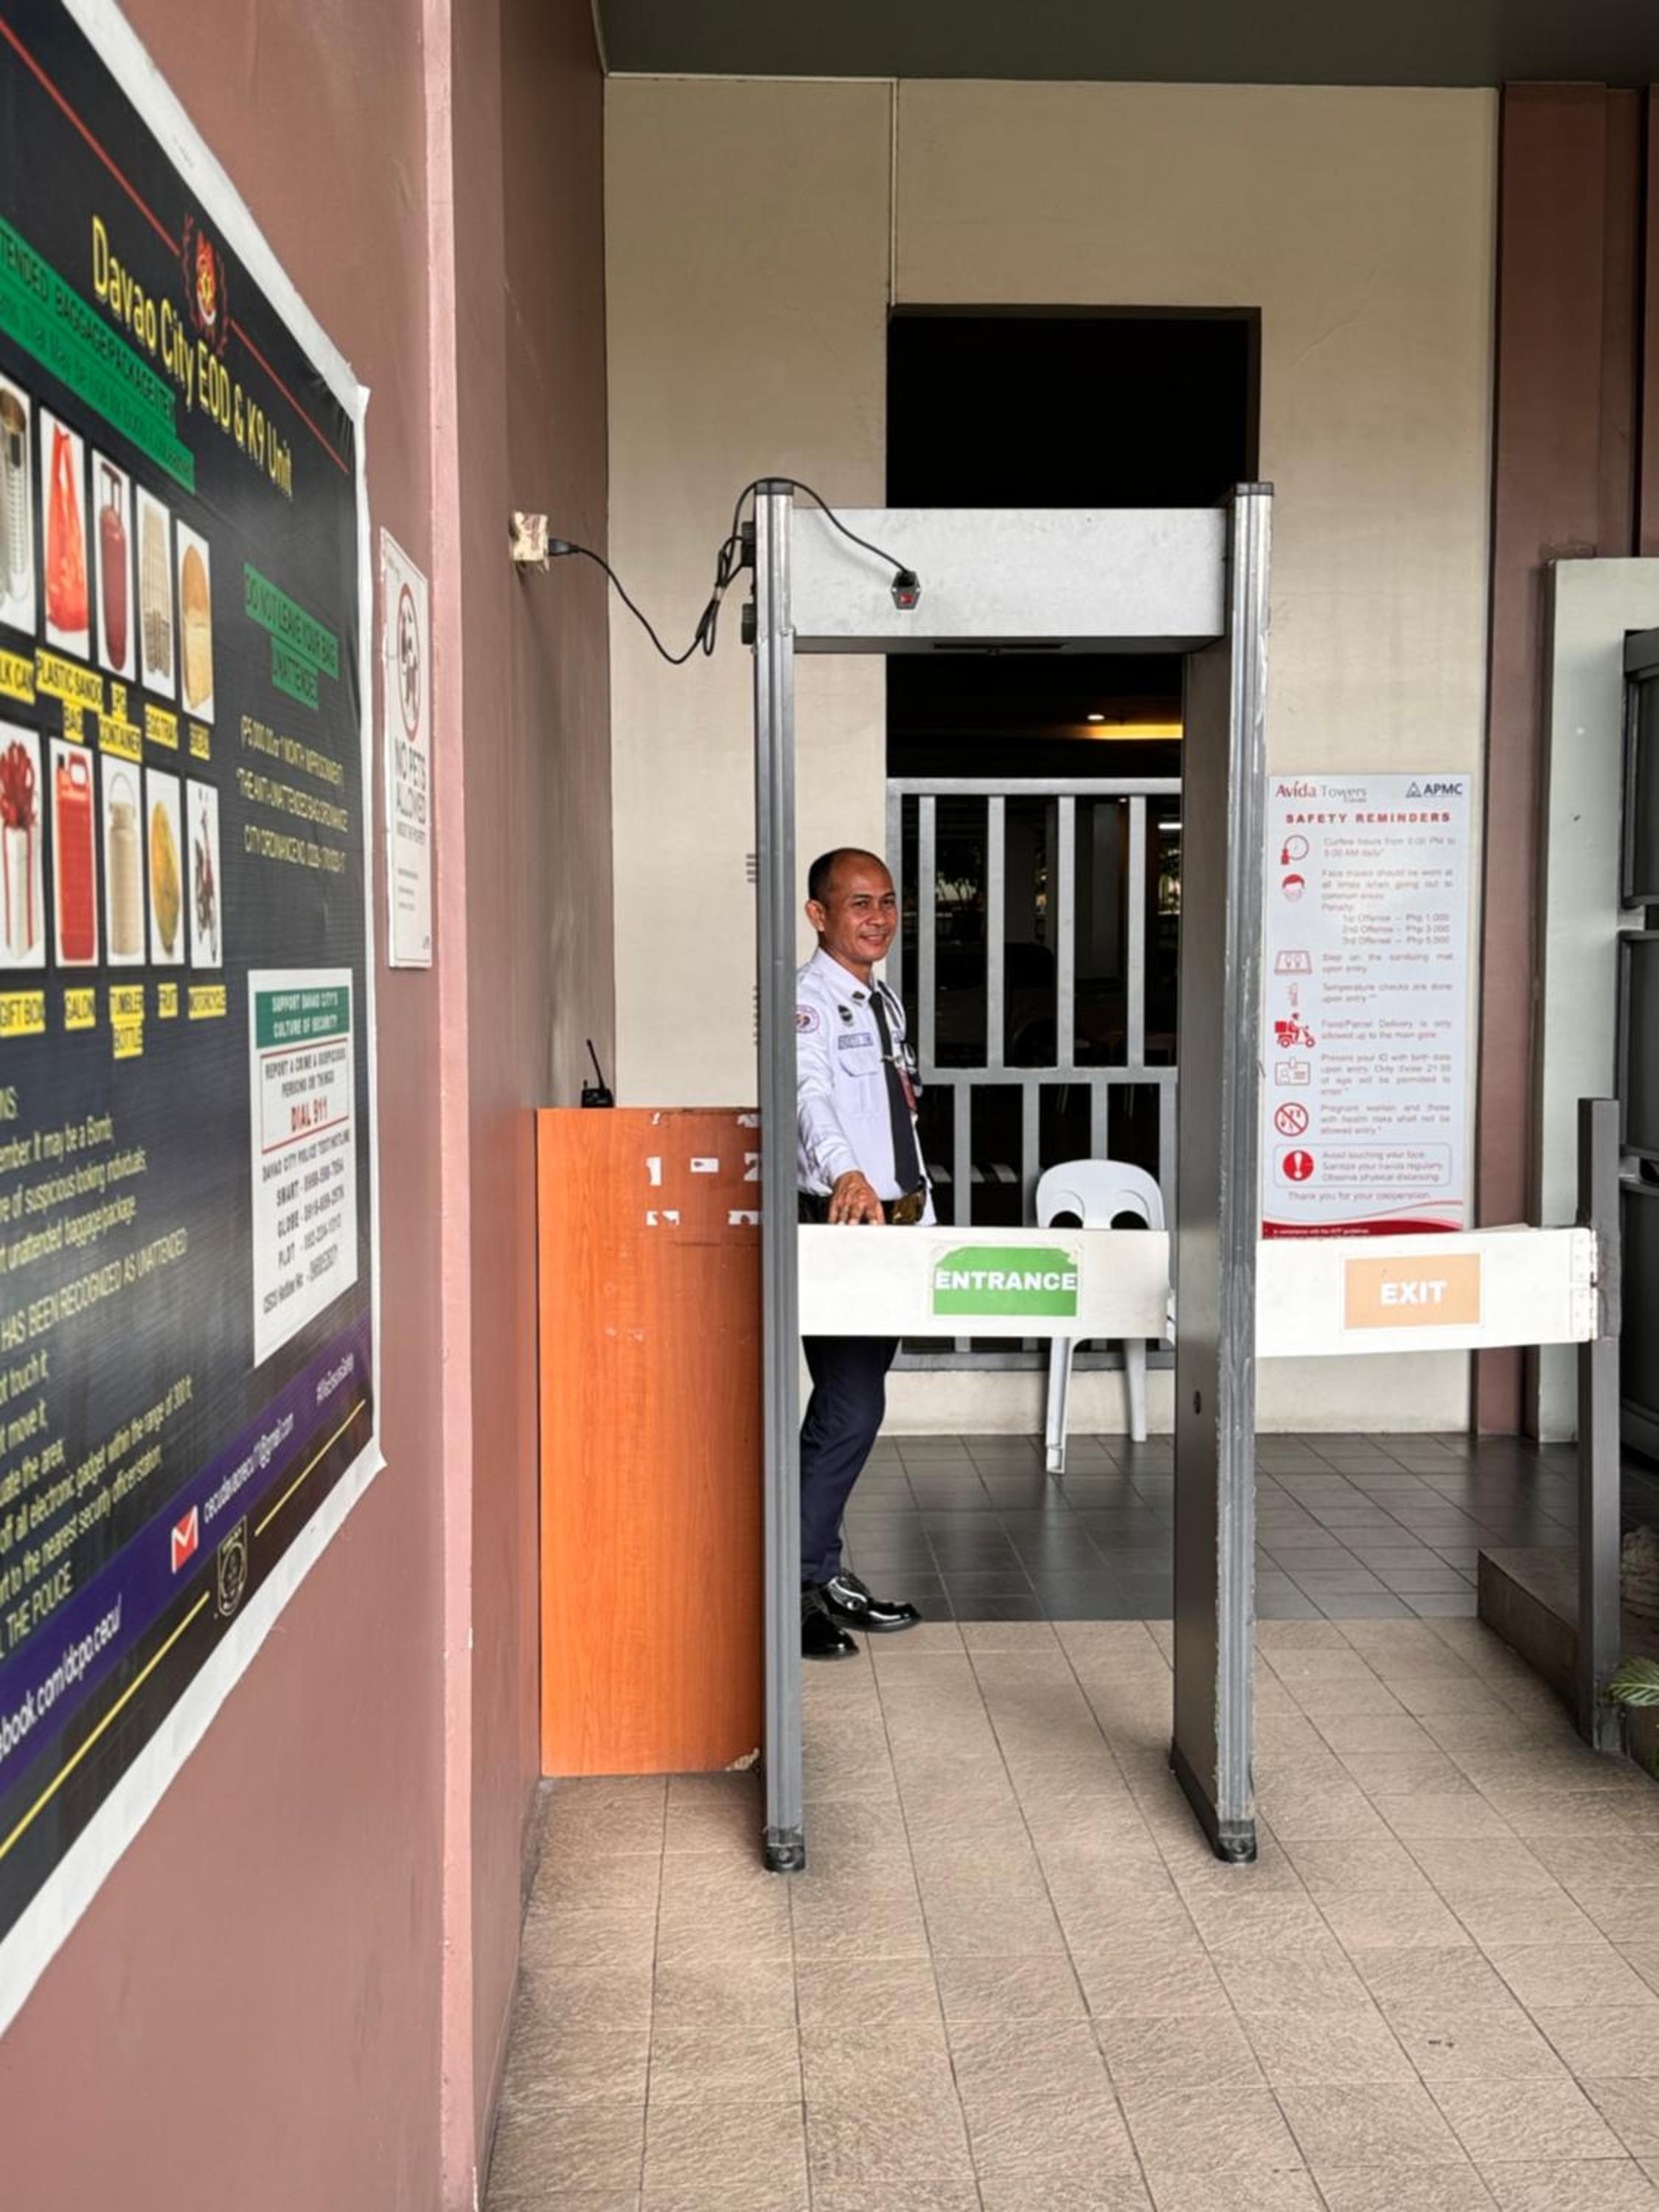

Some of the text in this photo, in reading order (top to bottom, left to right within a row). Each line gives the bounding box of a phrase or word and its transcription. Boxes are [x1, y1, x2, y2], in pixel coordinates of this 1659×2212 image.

[92, 215, 293, 498] Davao City EOD & K9 Unit
[1321, 784, 1367, 799] Towers
[1423, 782, 1464, 796] APMC
[1285, 812, 1451, 824] SAFETY REMINDERS
[936, 1271, 1078, 1291] ENTRANCE
[1380, 1281, 1447, 1305] EXIT
[7, 1599, 30, 1649] THE
[32, 1559, 73, 1624] POLICE
